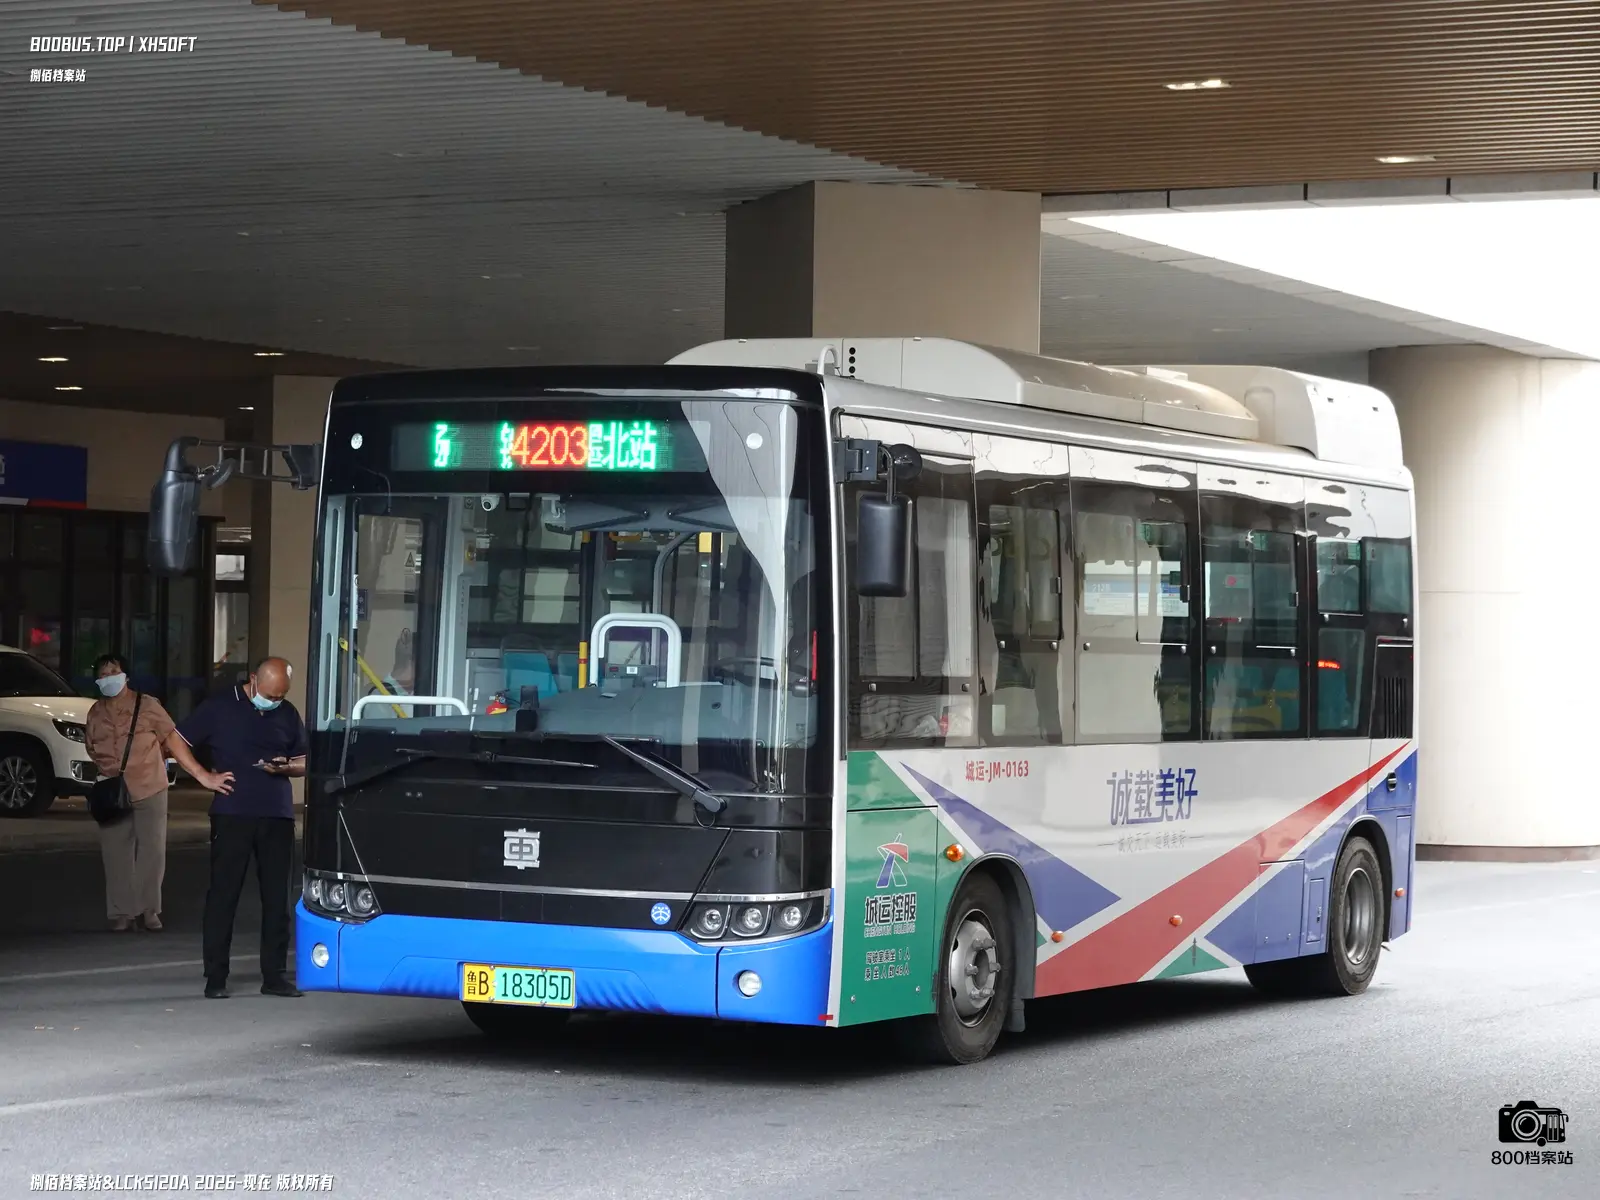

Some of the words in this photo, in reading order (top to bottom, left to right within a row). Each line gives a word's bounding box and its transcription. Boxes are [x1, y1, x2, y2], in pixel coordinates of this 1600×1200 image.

[511, 426, 588, 466] 4203
[1106, 768, 1198, 825] 诚载美好
[864, 892, 917, 926] 城运控股
[467, 971, 490, 996] 鲁B
[501, 972, 571, 1000] 18305D
